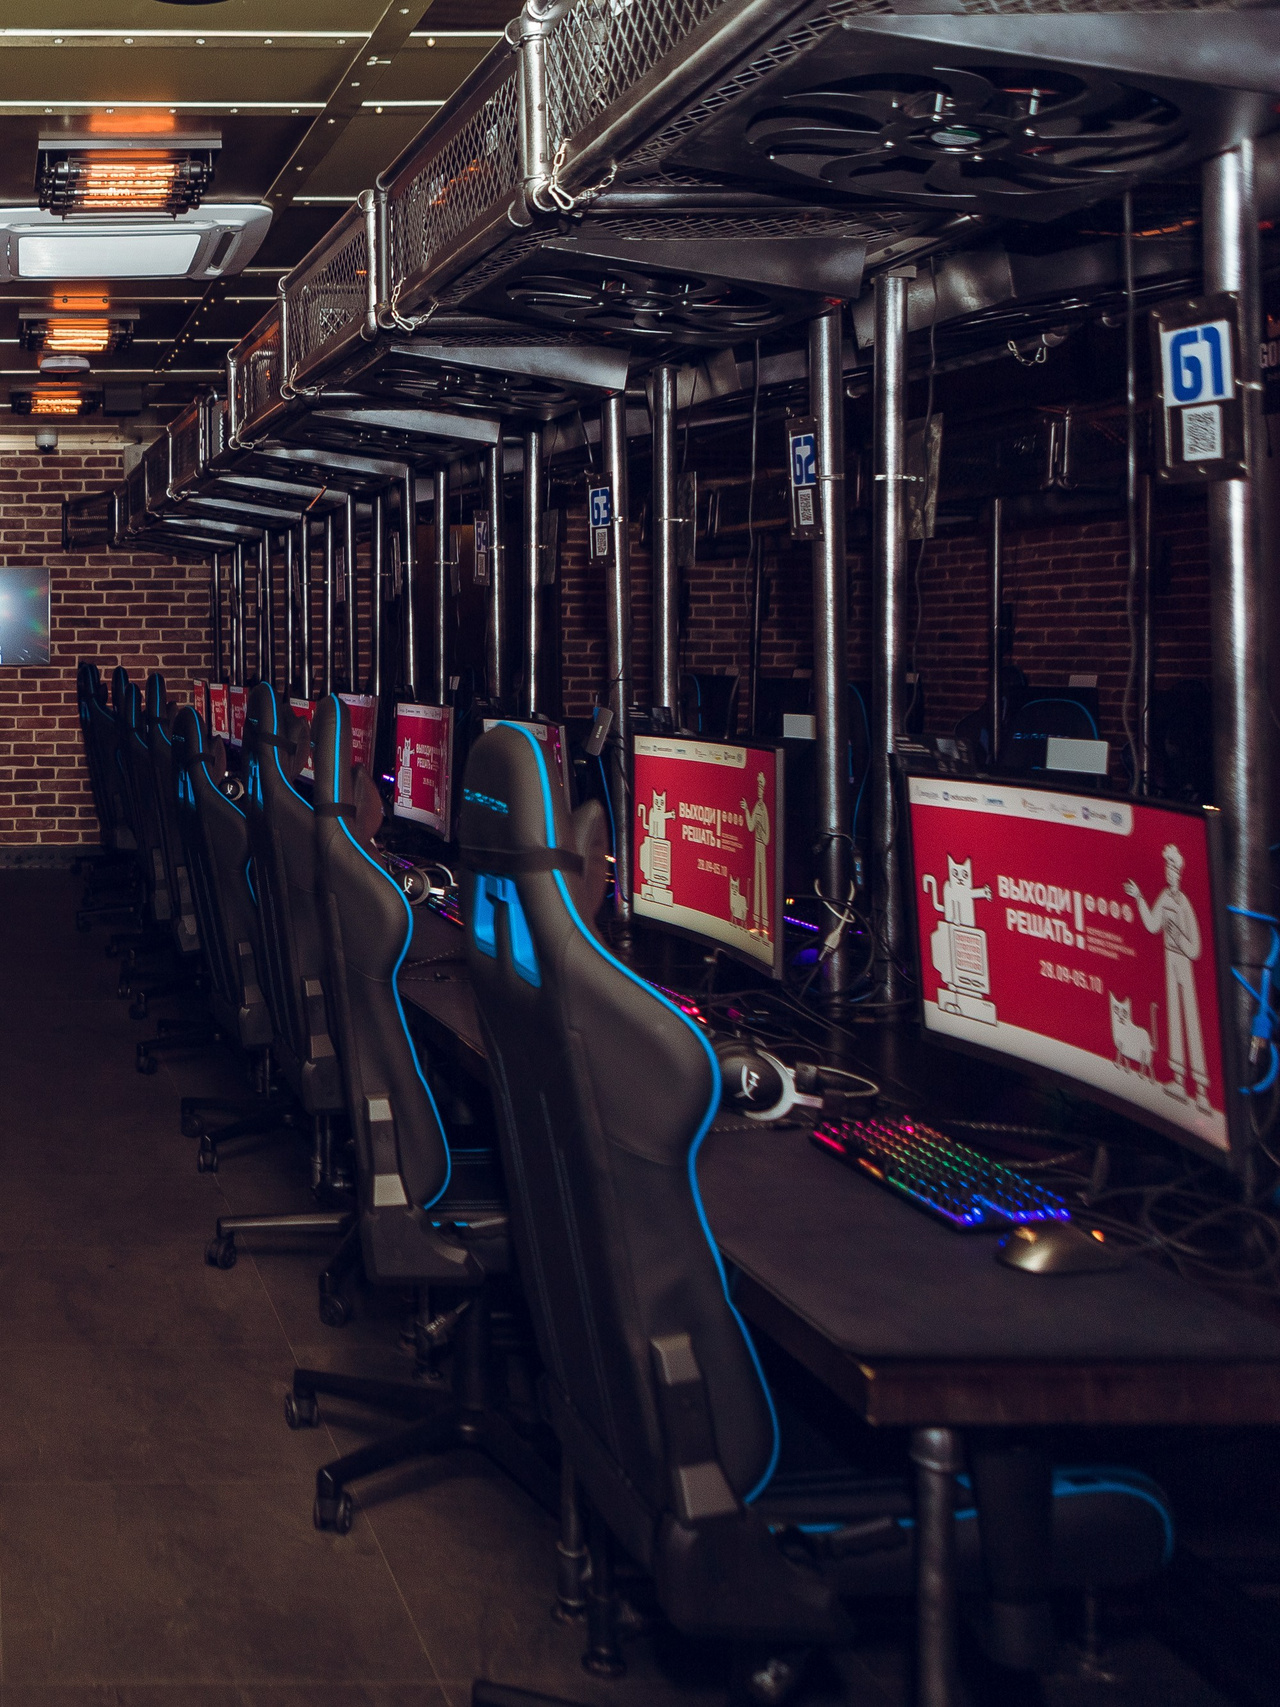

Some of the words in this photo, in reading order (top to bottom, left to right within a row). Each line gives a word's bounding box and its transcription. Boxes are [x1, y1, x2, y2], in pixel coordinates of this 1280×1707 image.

[1170, 325, 1225, 403] 61
[791, 435, 816, 486] 62
[590, 488, 610, 527] 63
[679, 801, 716, 826] ВЫХОДИ
[997, 874, 1073, 915] ВЫХОДИ
[1038, 959, 1104, 995] 28.09-05.10
